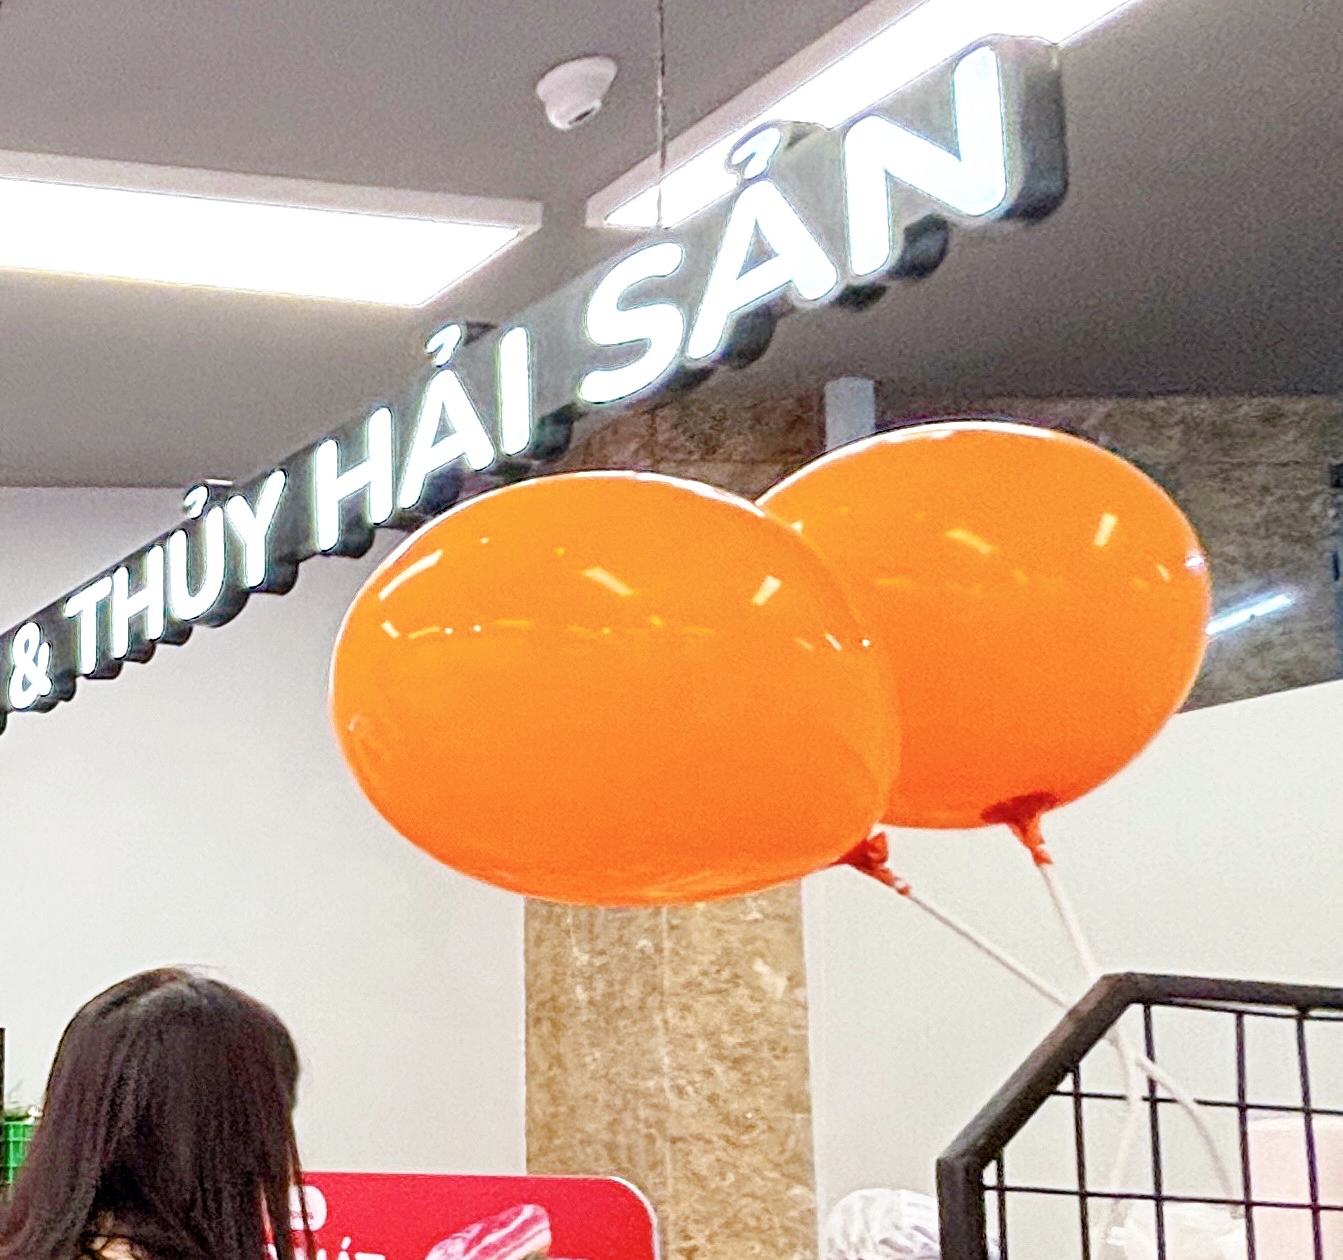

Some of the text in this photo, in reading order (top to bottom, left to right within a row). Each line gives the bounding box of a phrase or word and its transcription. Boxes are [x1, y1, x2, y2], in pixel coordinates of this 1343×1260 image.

[9, 622, 53, 710] &
[64, 469, 287, 676] THỦY
[316, 322, 533, 558] HẢI
[576, 44, 1008, 406] SẢN
